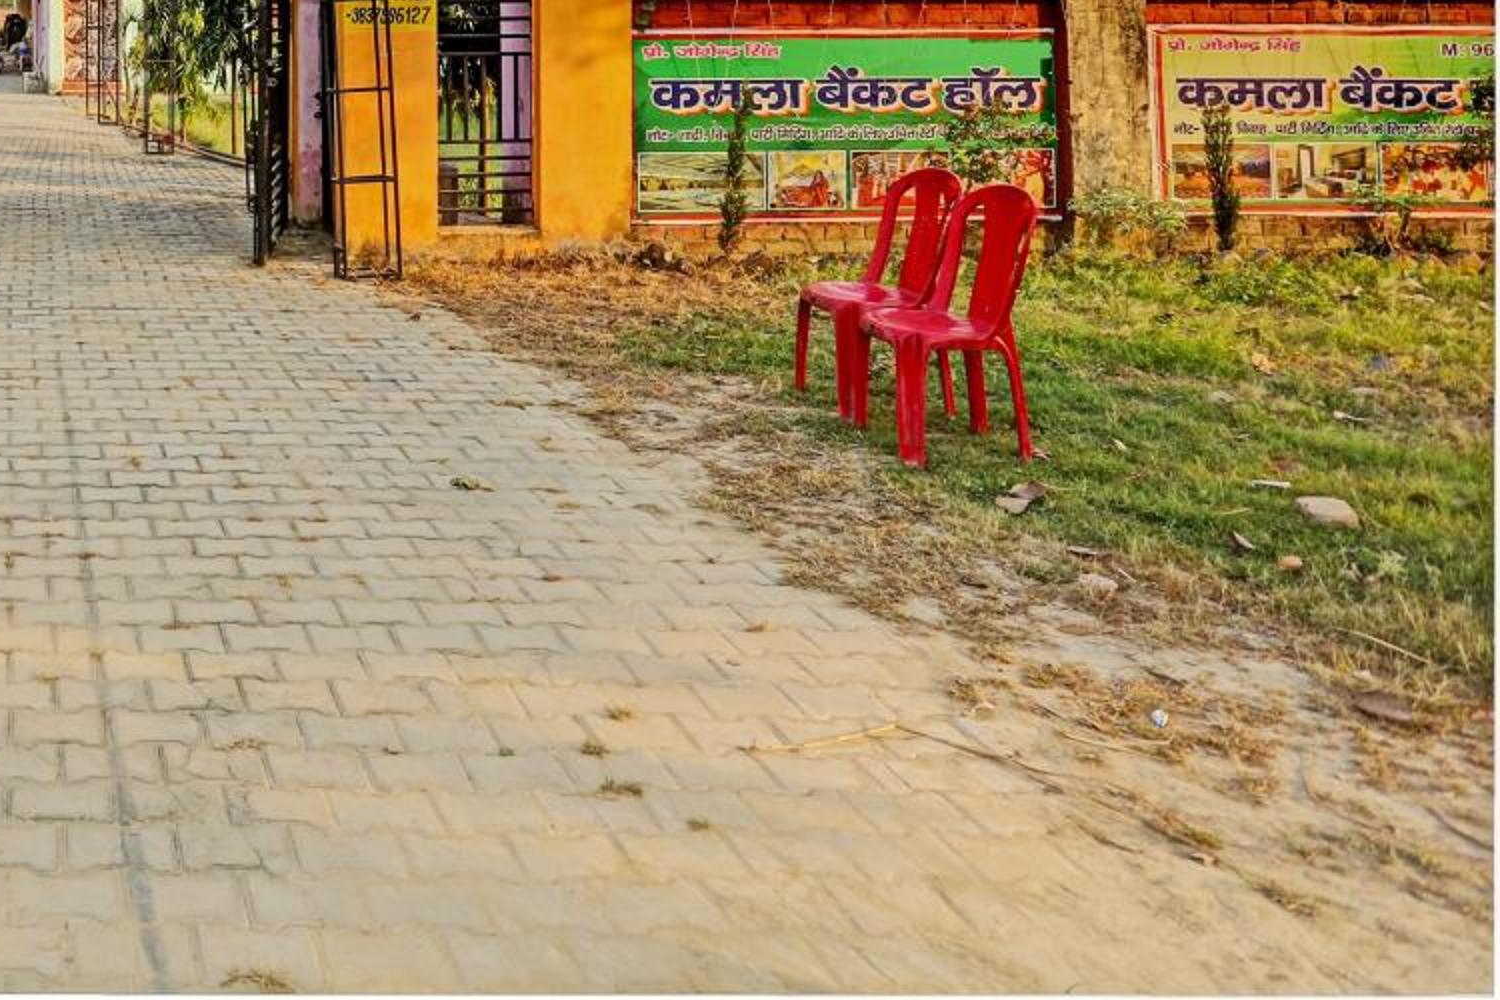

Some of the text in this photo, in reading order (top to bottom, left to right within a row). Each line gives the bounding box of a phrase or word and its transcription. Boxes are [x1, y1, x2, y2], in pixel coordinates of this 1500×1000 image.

[649, 64, 1043, 111] कमला बैंकट हॉल
[1174, 77, 1328, 110] कमला
[1338, 65, 1461, 109] बैंकट
